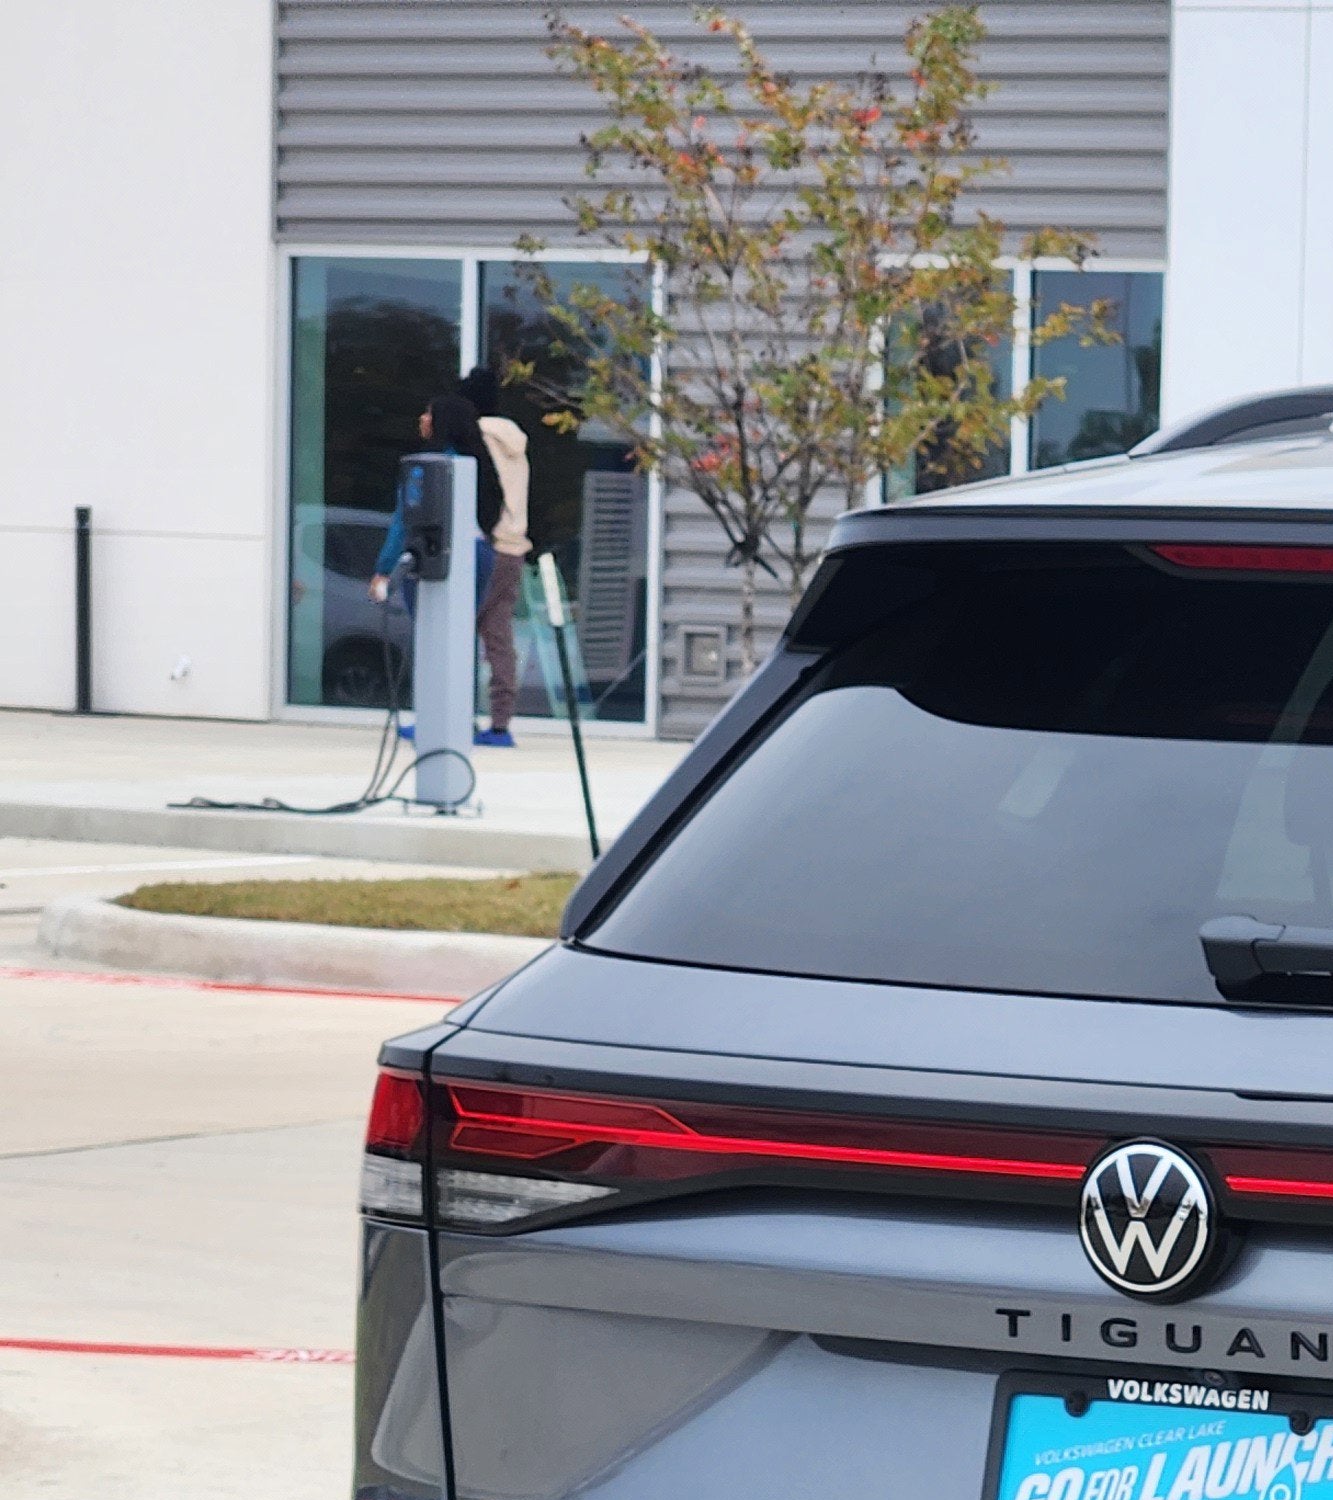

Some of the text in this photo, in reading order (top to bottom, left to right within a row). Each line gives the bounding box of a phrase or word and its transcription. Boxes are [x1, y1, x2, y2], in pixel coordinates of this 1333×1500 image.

[996, 1308, 1328, 1362] TIGUAN
[1106, 1379, 1269, 1411] VOLKSWAGEN
[1035, 1420, 1226, 1465] VOLKSWAGEN CLEAR LAKE
